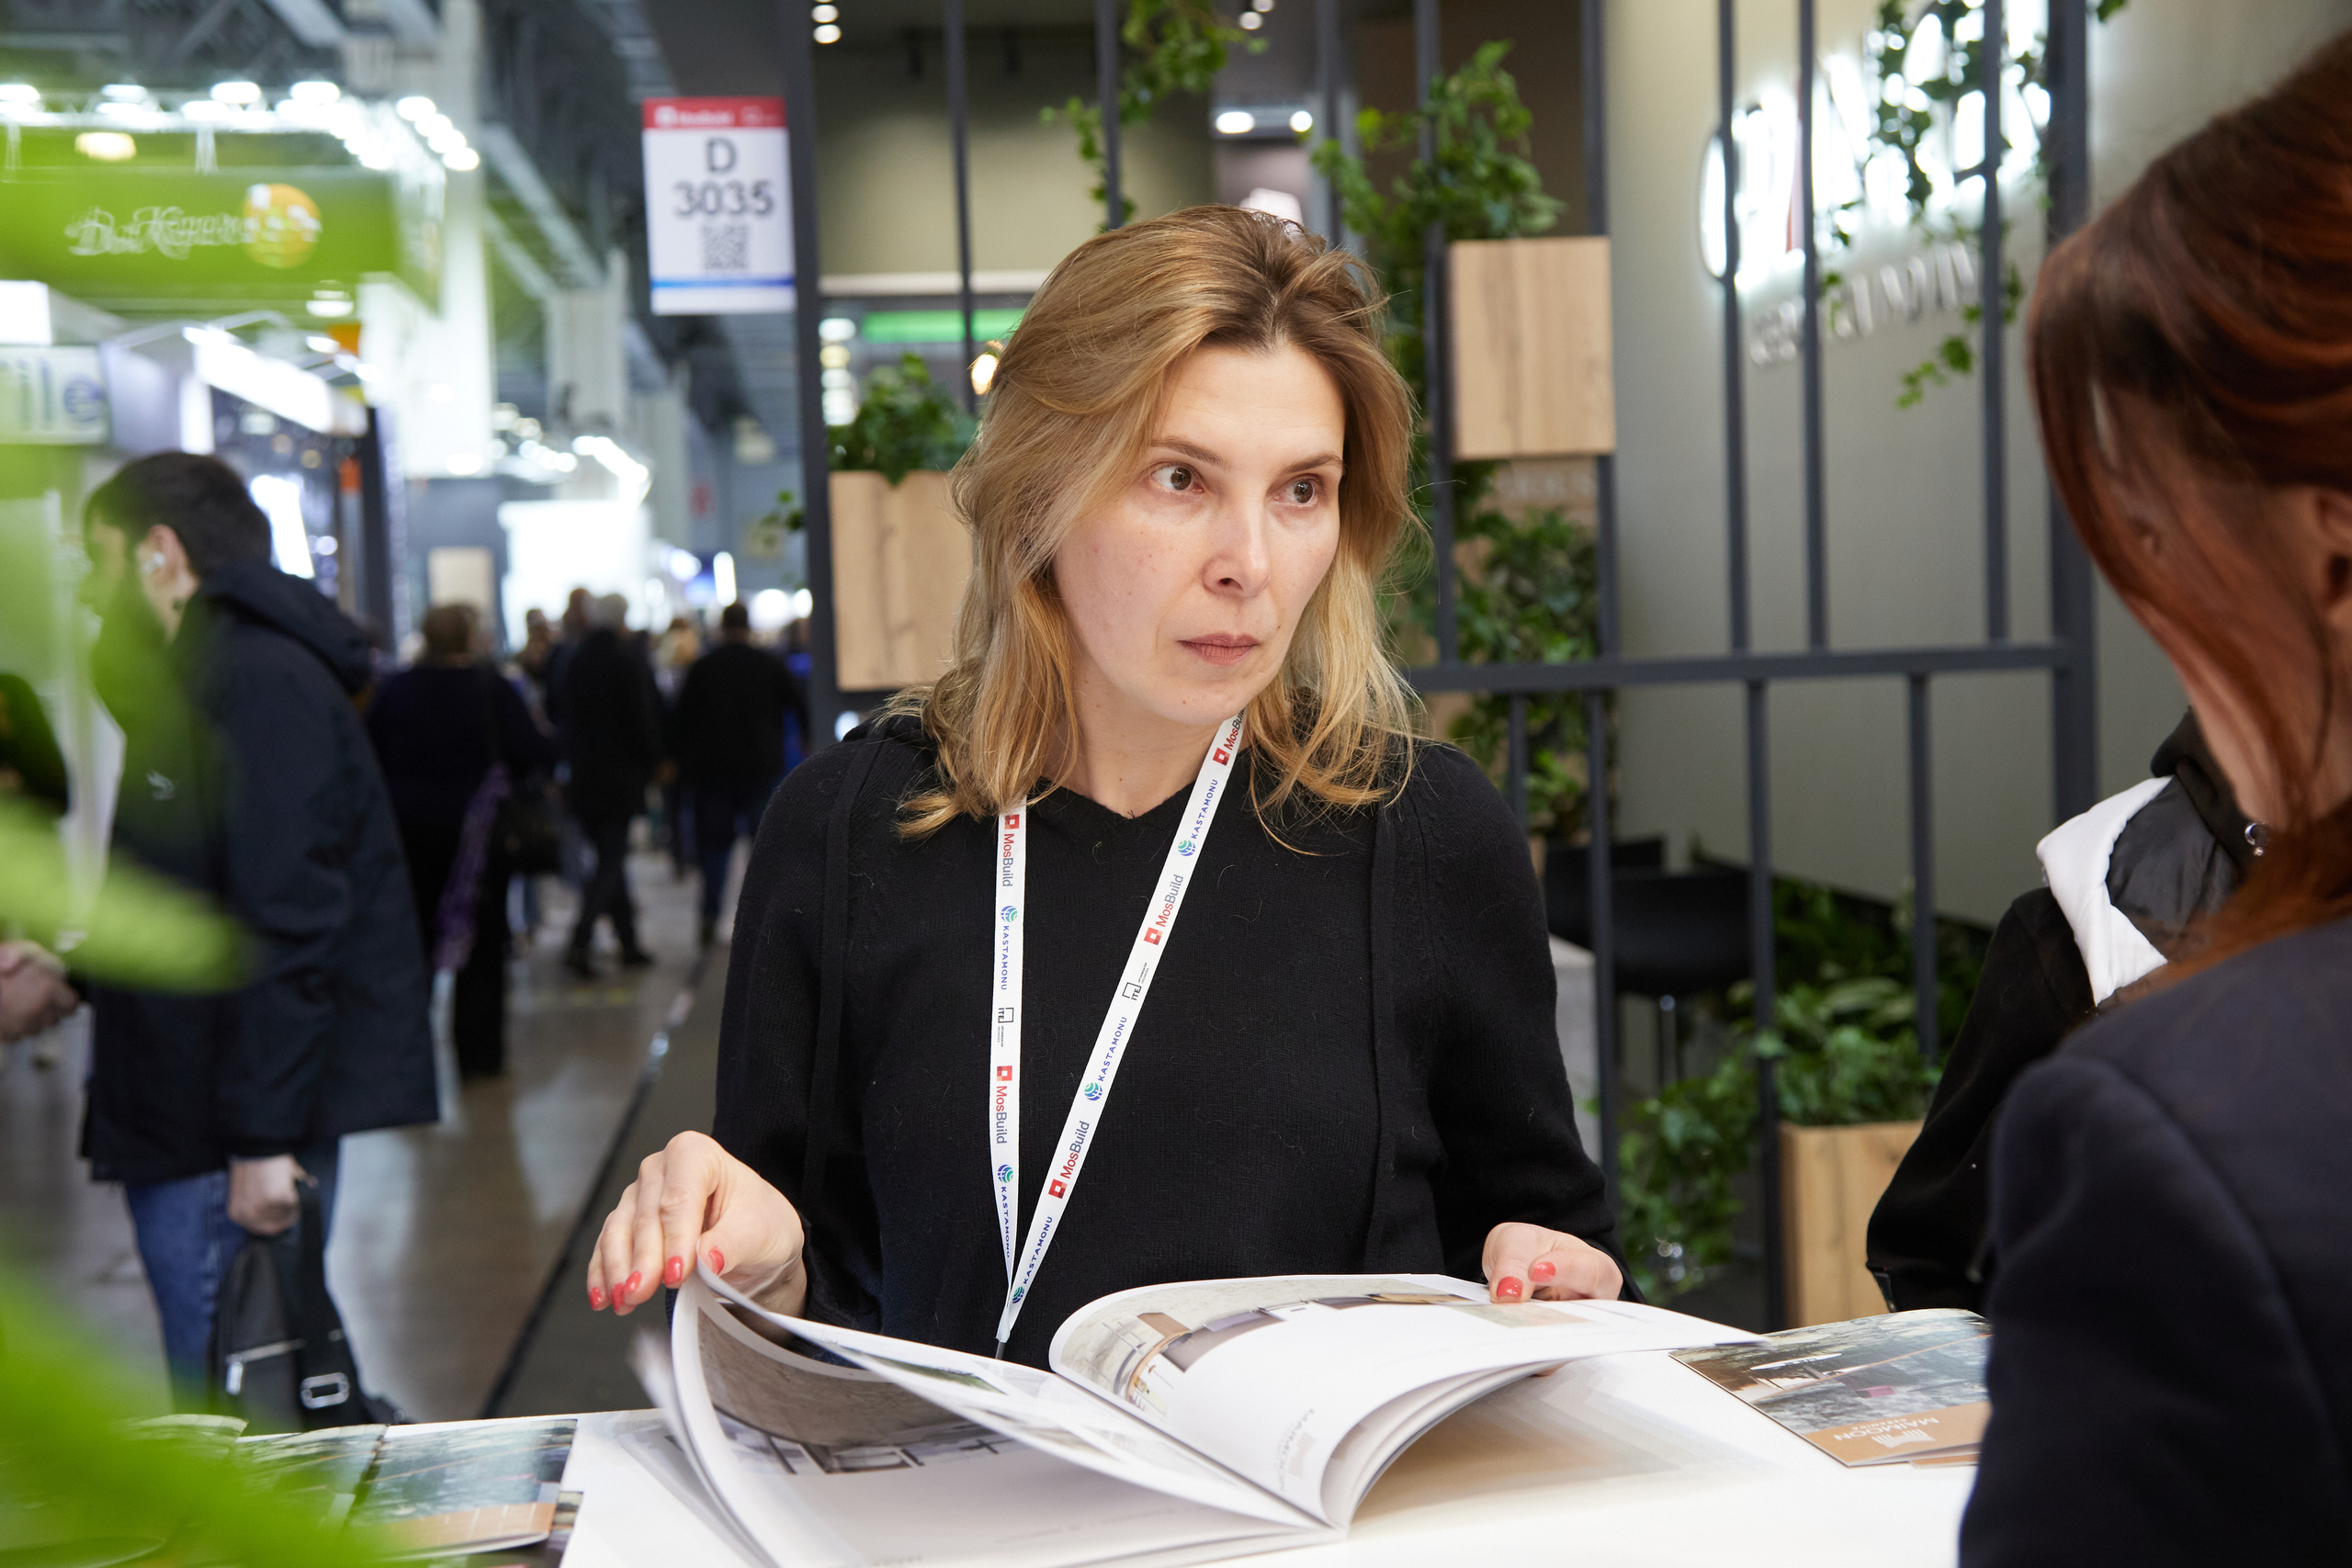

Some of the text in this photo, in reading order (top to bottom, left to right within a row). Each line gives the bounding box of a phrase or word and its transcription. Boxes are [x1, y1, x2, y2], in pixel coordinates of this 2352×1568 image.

[707, 137, 737, 174] D
[673, 180, 774, 219] 3035
[1191, 779, 1218, 840] KASTAMONU
[1002, 833, 1015, 887] MosBuild
[1155, 874, 1184, 928] MosBuild
[1001, 925, 1010, 990] KASTAMONU
[1098, 1016, 1128, 1082] KASTAMONU
[996, 1085, 1008, 1145] MosBuild
[1059, 1120, 1091, 1179] MosBuild
[1001, 1186, 1011, 1258] KASTAMONU
[1023, 1215, 1054, 1285] KASTAMONU
[1833, 1417, 1939, 1441] MAIMOON
